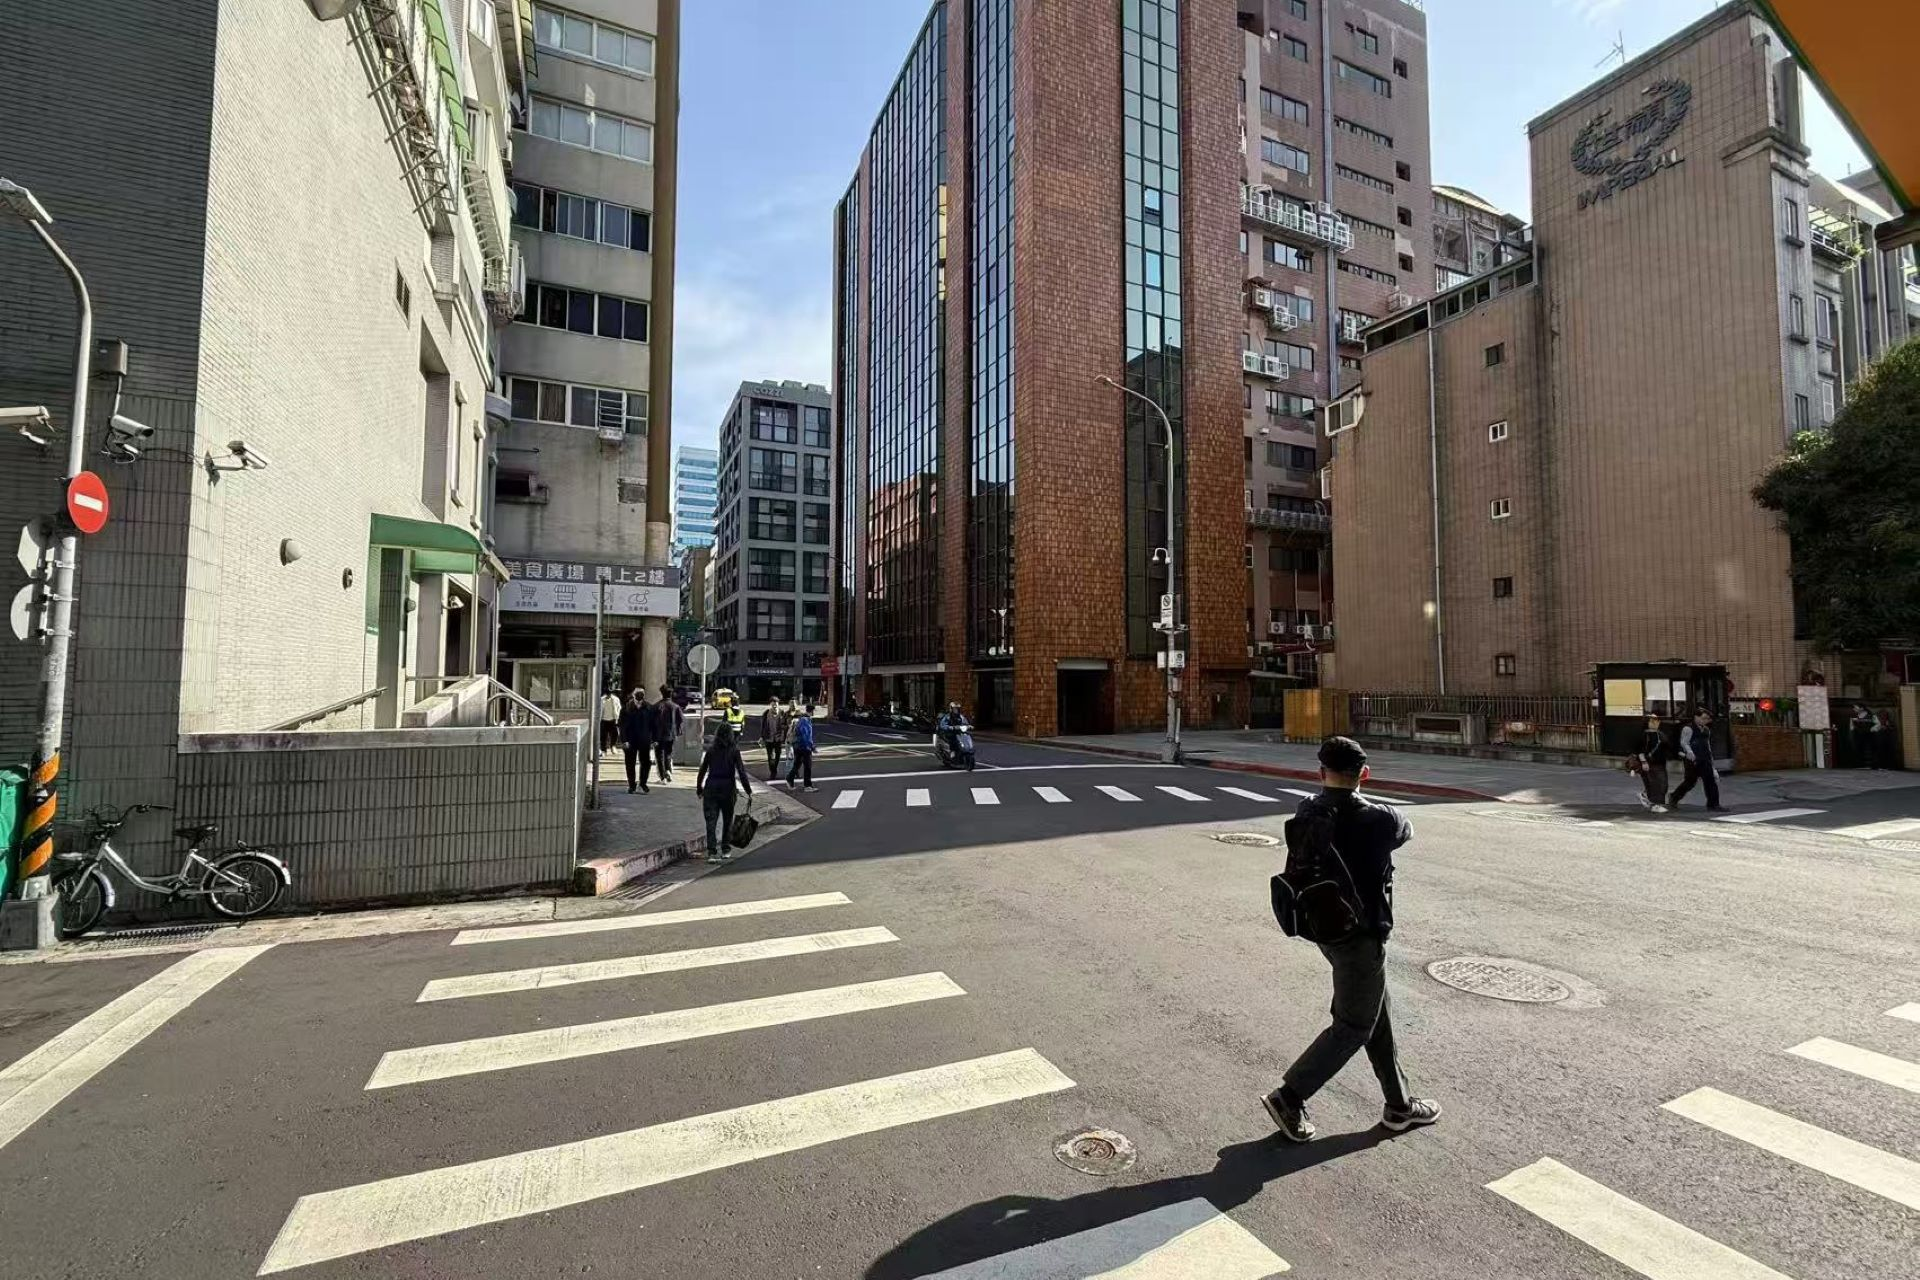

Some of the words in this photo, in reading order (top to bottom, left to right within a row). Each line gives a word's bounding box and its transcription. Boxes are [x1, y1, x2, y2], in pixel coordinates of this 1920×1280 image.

[753, 385, 784, 396] COZZI
[505, 561, 584, 580] 美食廣場
